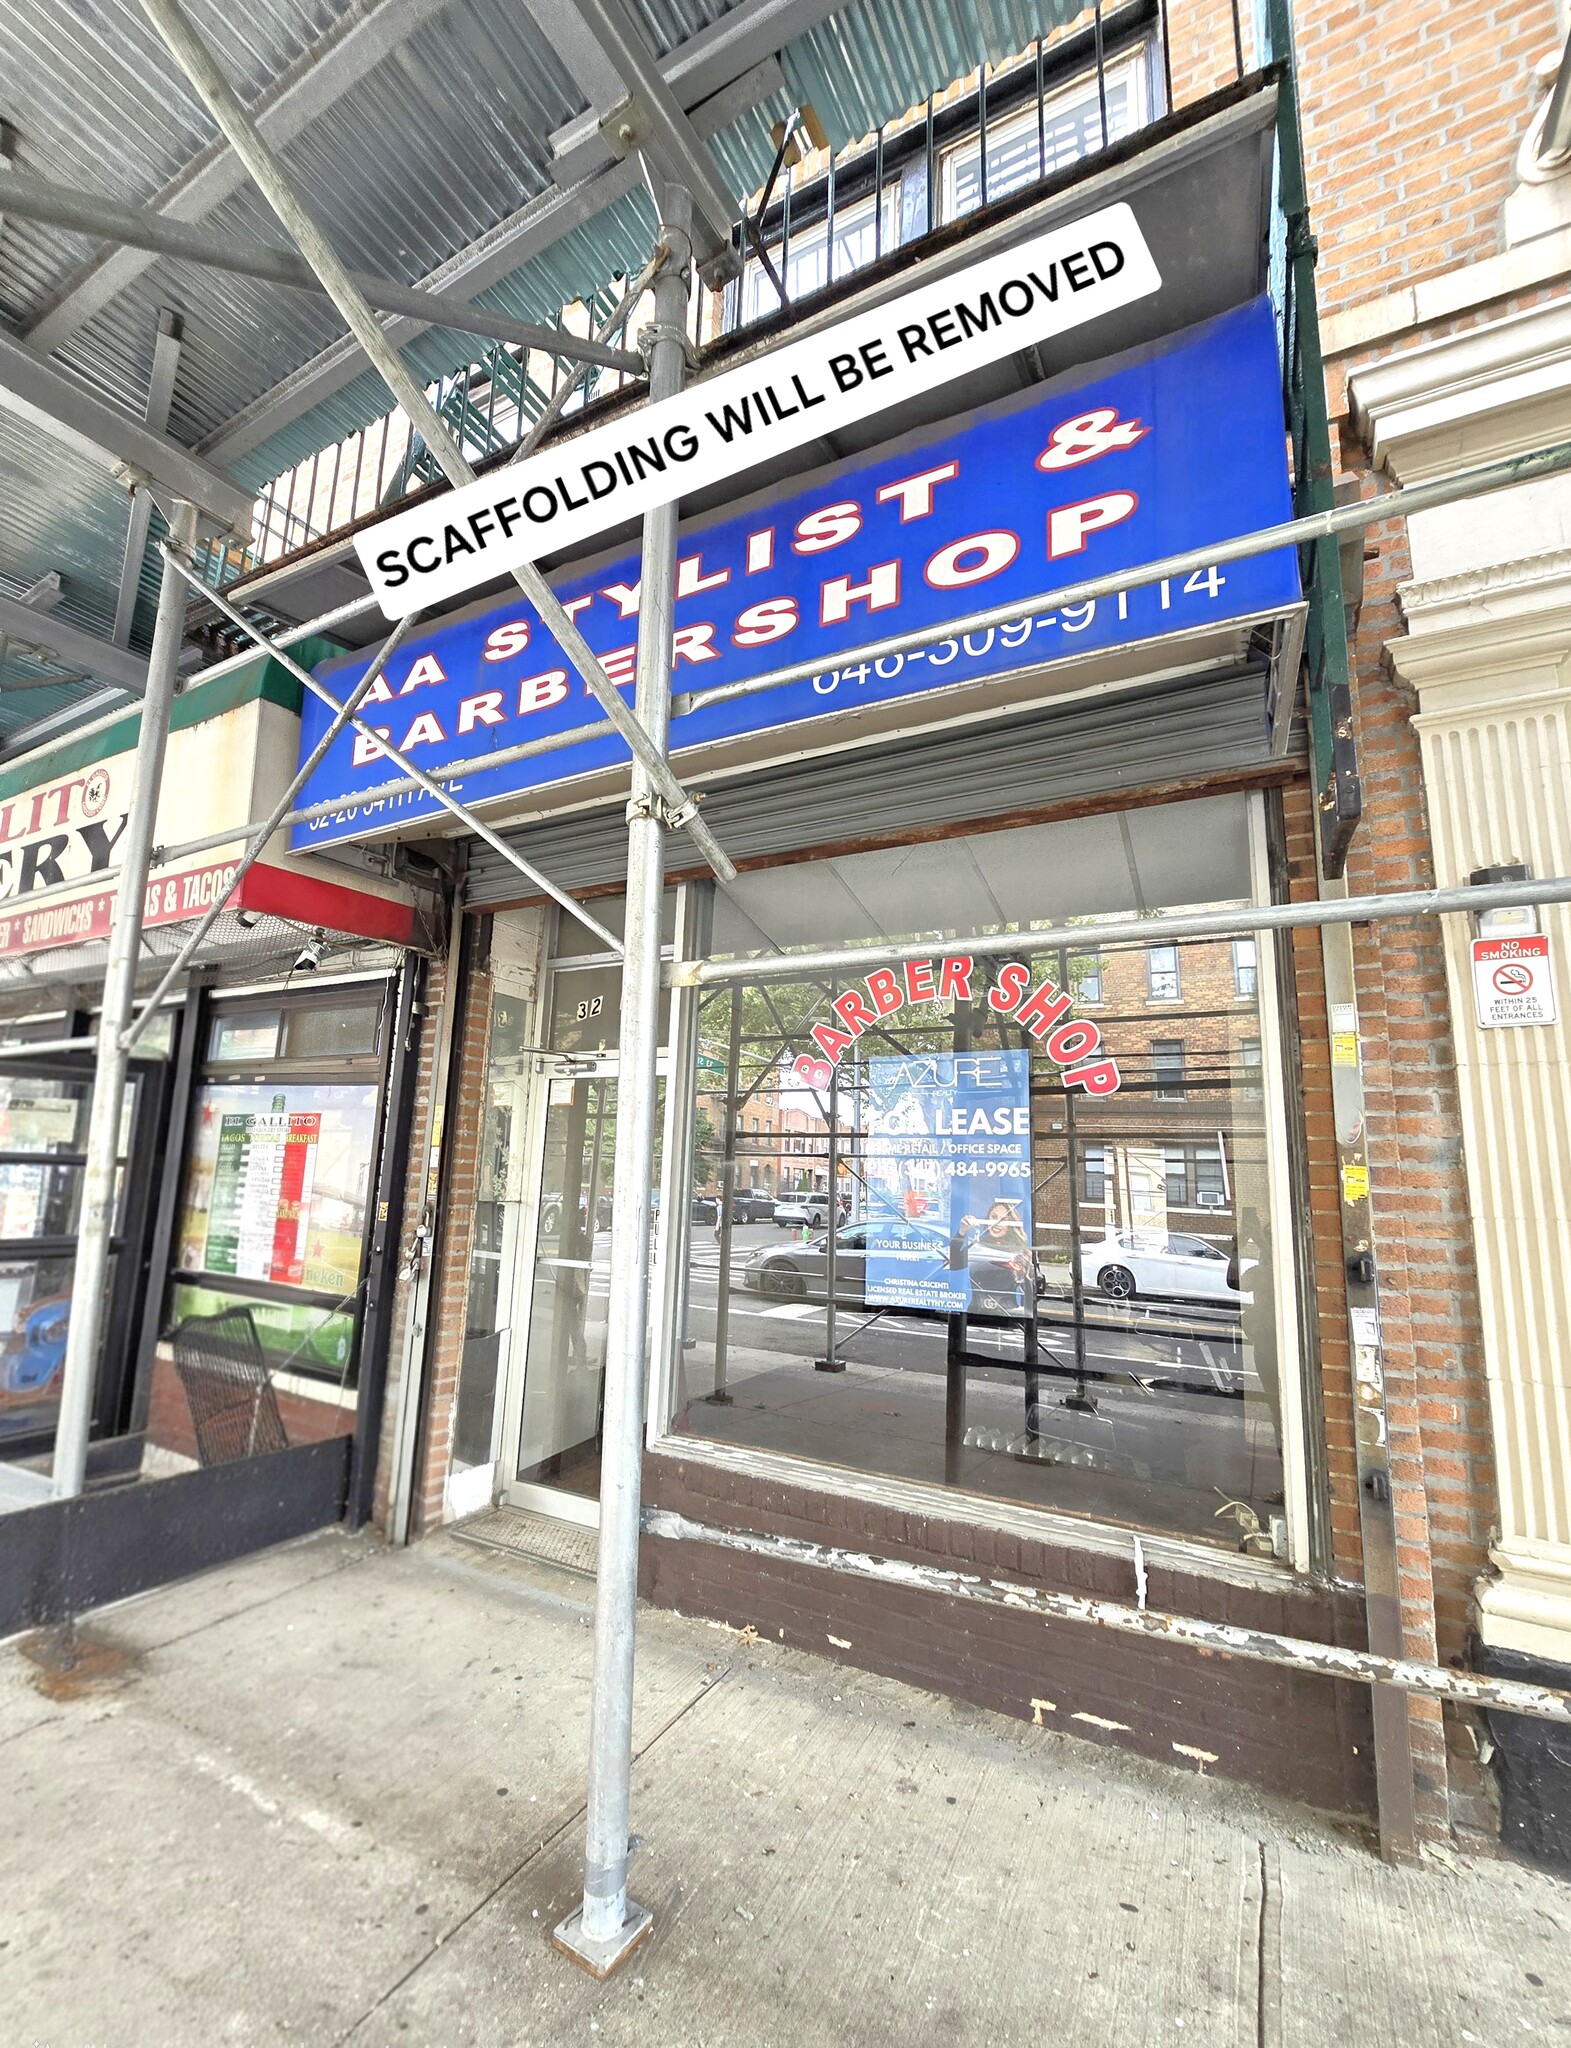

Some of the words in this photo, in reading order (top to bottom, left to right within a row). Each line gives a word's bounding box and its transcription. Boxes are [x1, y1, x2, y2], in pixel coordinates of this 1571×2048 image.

[355, 653, 447, 711] AA
[484, 459, 959, 663] STYLIST
[1035, 407, 1152, 472] &
[351, 490, 1138, 768] BARBERSHOP
[22, 897, 94, 944] SANDWICHS
[164, 880, 177, 913] &
[183, 866, 236, 910] TACOS
[1501, 941, 1519, 950] NO
[1481, 948, 1541, 960] SMOKING
[578, 998, 601, 1019] 32
[1492, 1011, 1543, 1020] ENTRANCES
[792, 956, 974, 1091] BARBER
[987, 962, 1121, 1097] SHOP
[889, 1057, 1002, 1089] AZURE
[224, 1117, 243, 1127] EL
[246, 1116, 316, 1127] GALLITO
[935, 1107, 1030, 1136] LEASE
[221, 1133, 246, 1142] TACOS
[286, 1134, 318, 1143] BREAKFAST
[949, 1143, 985, 1154] OFFICE
[987, 1143, 1022, 1154] SPACE
[945, 1161, 1031, 1178] 484-9965
[876, 1239, 900, 1249] YOUR
[902, 1240, 943, 1251] BUSINESS
[884, 1278, 918, 1287] CHRISTINA
[867, 1286, 897, 1294] LICENSED
[915, 1289, 938, 1298] ESTATE
[940, 1292, 967, 1300] BROKER
